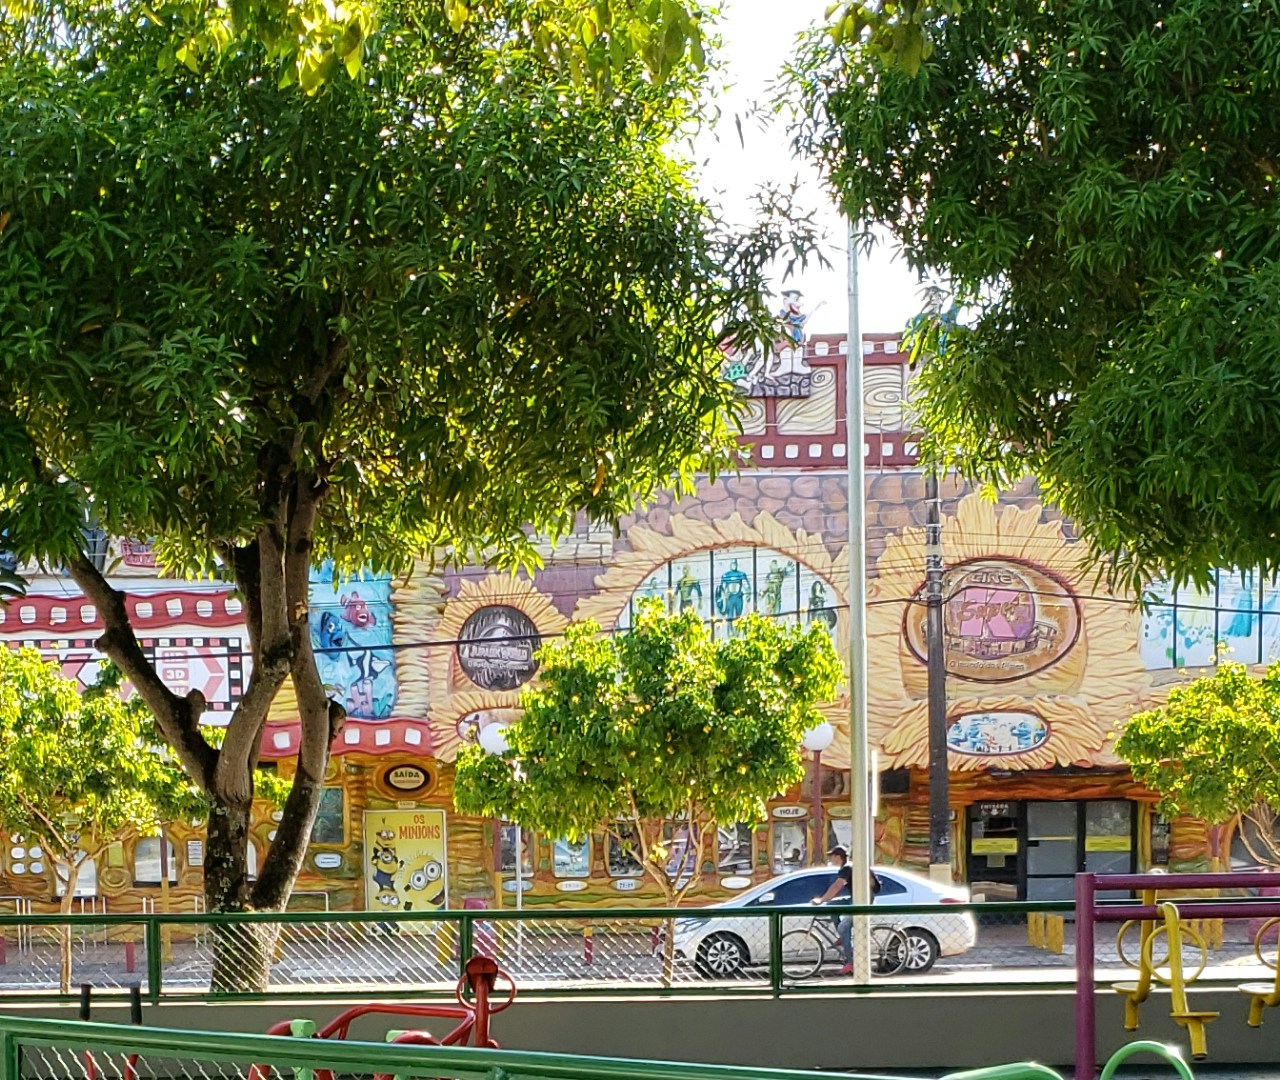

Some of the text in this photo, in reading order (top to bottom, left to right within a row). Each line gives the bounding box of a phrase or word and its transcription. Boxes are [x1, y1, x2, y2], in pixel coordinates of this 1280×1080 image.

[970, 571, 1013, 585] CINE
[394, 770, 420, 778] SAÍDA
[413, 815, 425, 825] OS
[399, 825, 441, 839] MINIONS
